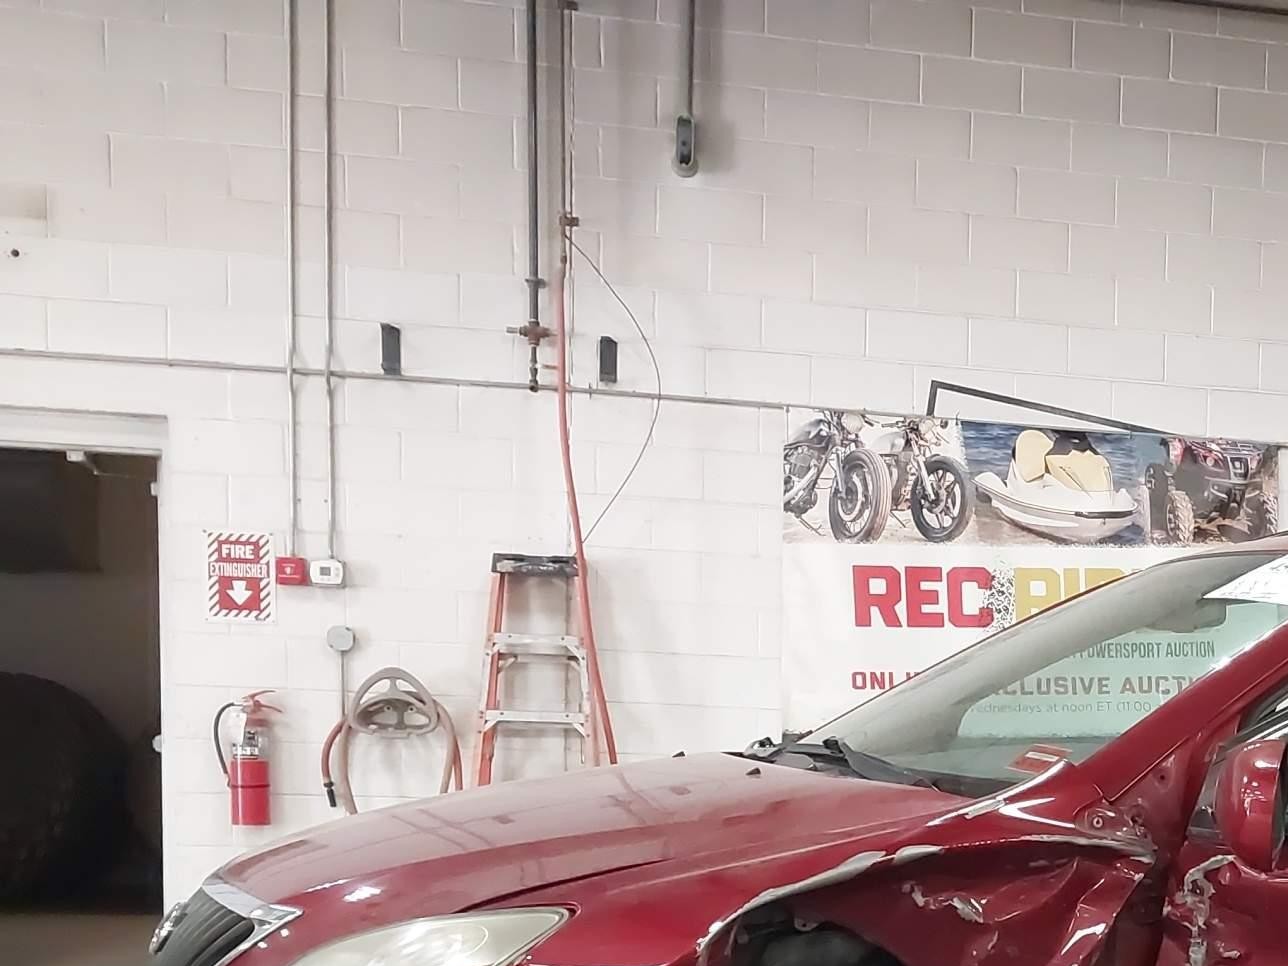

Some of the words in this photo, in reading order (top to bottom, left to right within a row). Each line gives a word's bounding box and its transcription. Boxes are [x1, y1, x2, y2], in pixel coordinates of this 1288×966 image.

[221, 543, 255, 559] FIRE
[209, 562, 268, 579] EXTINGUISHER
[852, 565, 995, 628] REC
[1165, 641, 1216, 659] AUCTION
[970, 701, 1042, 715] ednesdays
[1061, 703, 1092, 712] noon
[1096, 701, 1112, 712] ET
